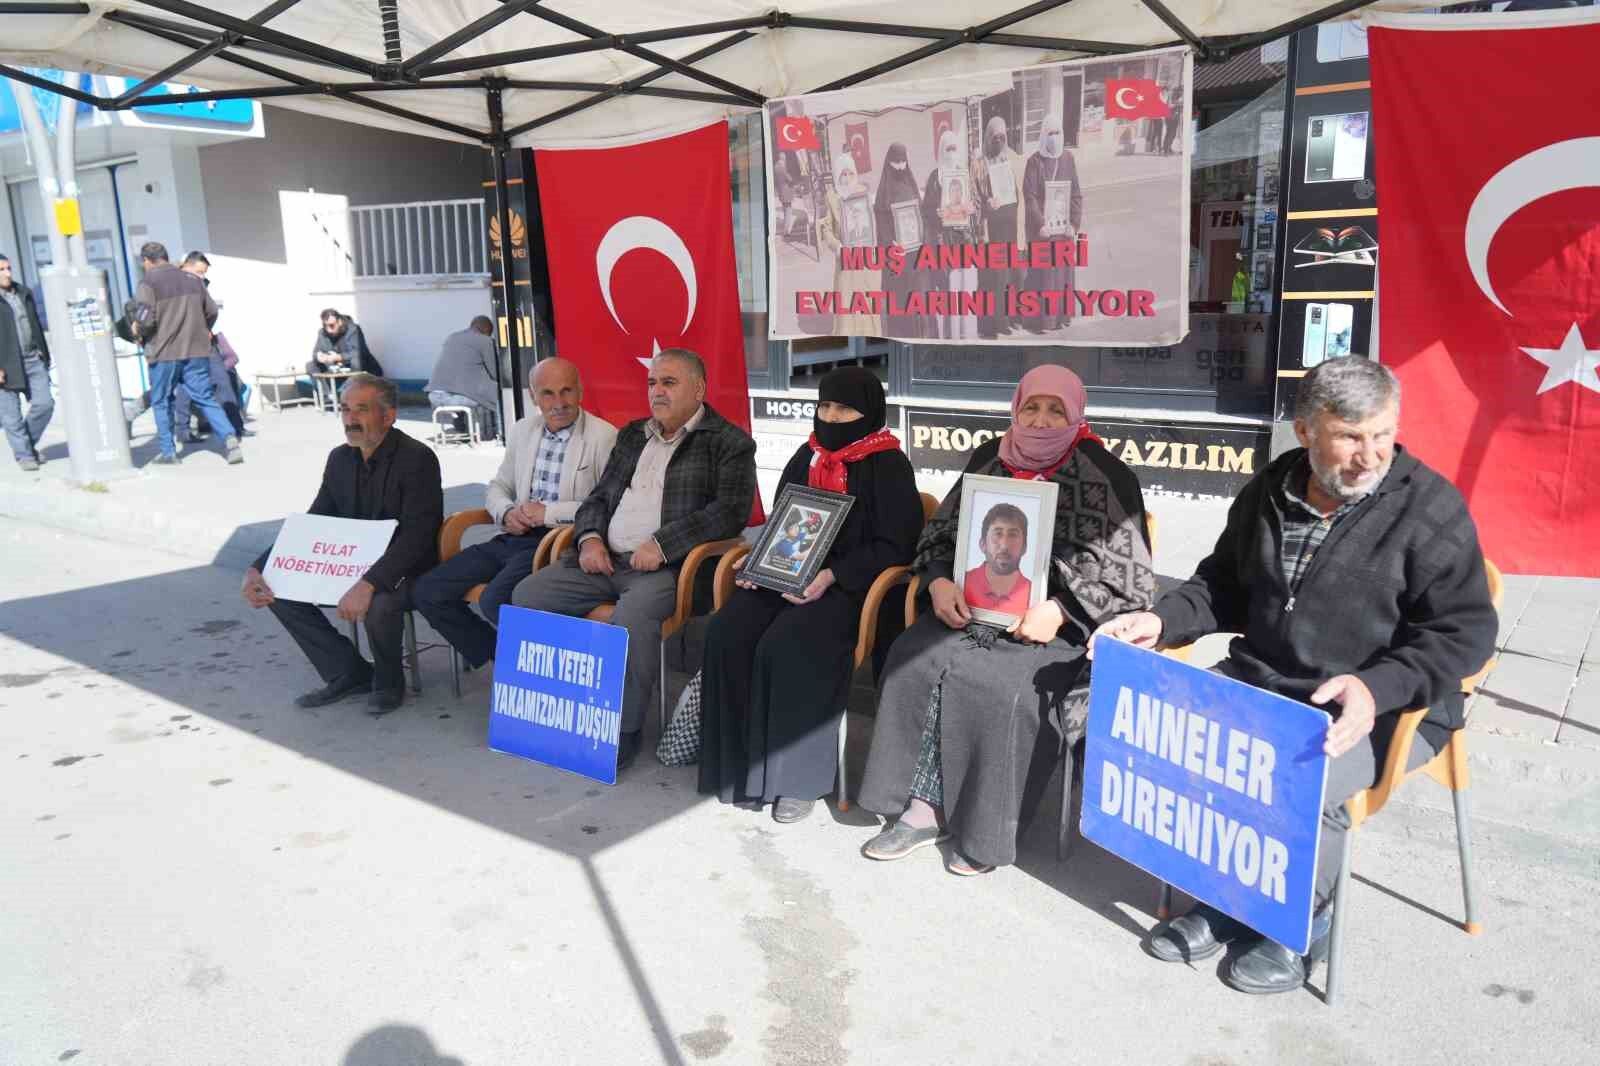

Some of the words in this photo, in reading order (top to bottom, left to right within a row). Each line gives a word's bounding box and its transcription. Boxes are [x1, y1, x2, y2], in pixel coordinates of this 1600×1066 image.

[840, 244, 906, 276] MUŞ
[914, 232, 1089, 271] ANNELERİ
[795, 290, 996, 317] EVLATLARINI
[1006, 283, 1156, 318] İSTİYOR
[766, 400, 817, 419] HOŞG
[312, 541, 358, 558] EVLAT
[516, 640, 556, 680] ARTIK
[558, 647, 596, 688] YETER
[494, 681, 575, 734] YAKAMIZDAN
[575, 697, 621, 751] DÜŞÜN
[1110, 685, 1277, 806] ANNELER
[1099, 756, 1289, 904] DİRENİYOR
